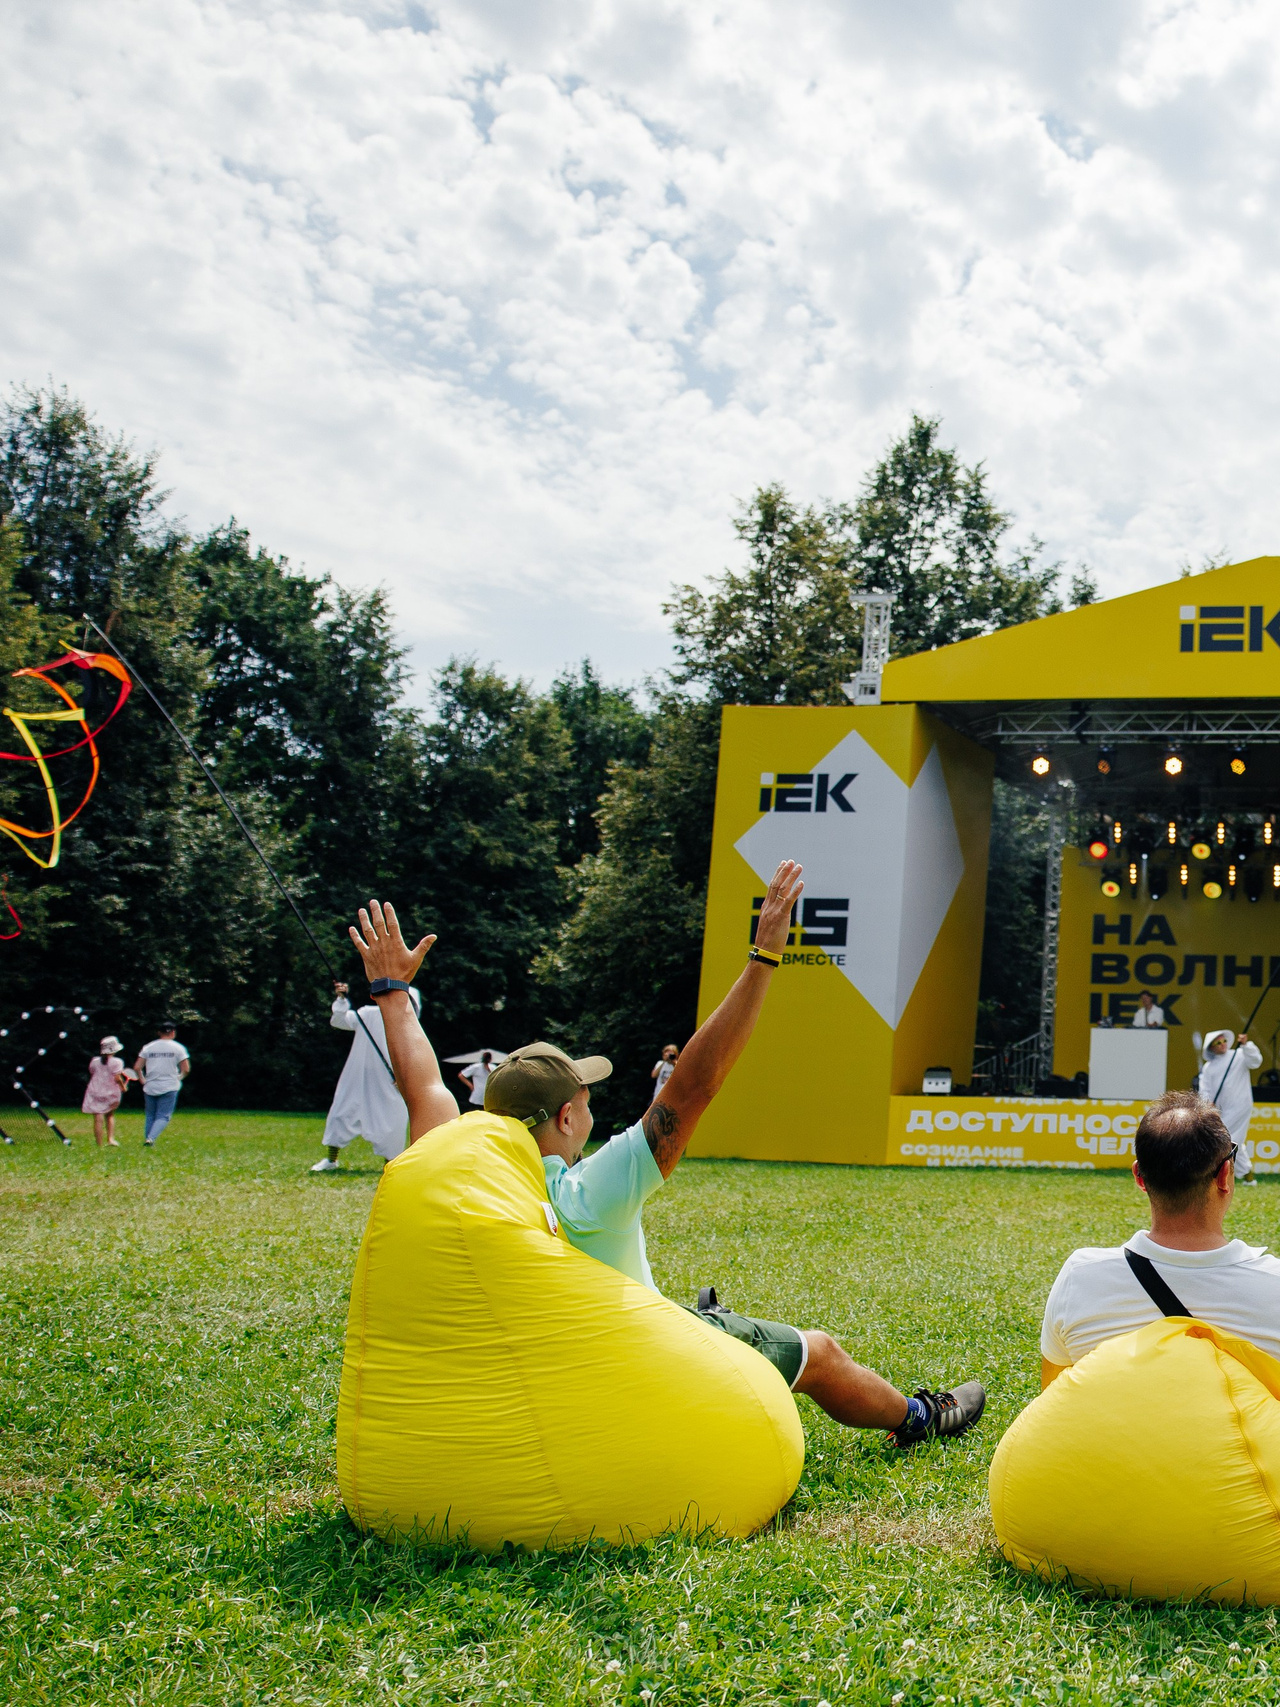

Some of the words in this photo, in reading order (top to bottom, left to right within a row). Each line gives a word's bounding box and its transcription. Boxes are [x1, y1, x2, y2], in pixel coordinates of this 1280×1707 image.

[1091, 914, 1178, 946] НА
[781, 953, 847, 966] ВМЕСТЕ
[906, 1110, 1141, 1135] ДОСТУПНОС
[900, 1143, 1024, 1159] СОЗИДАНИЕ
